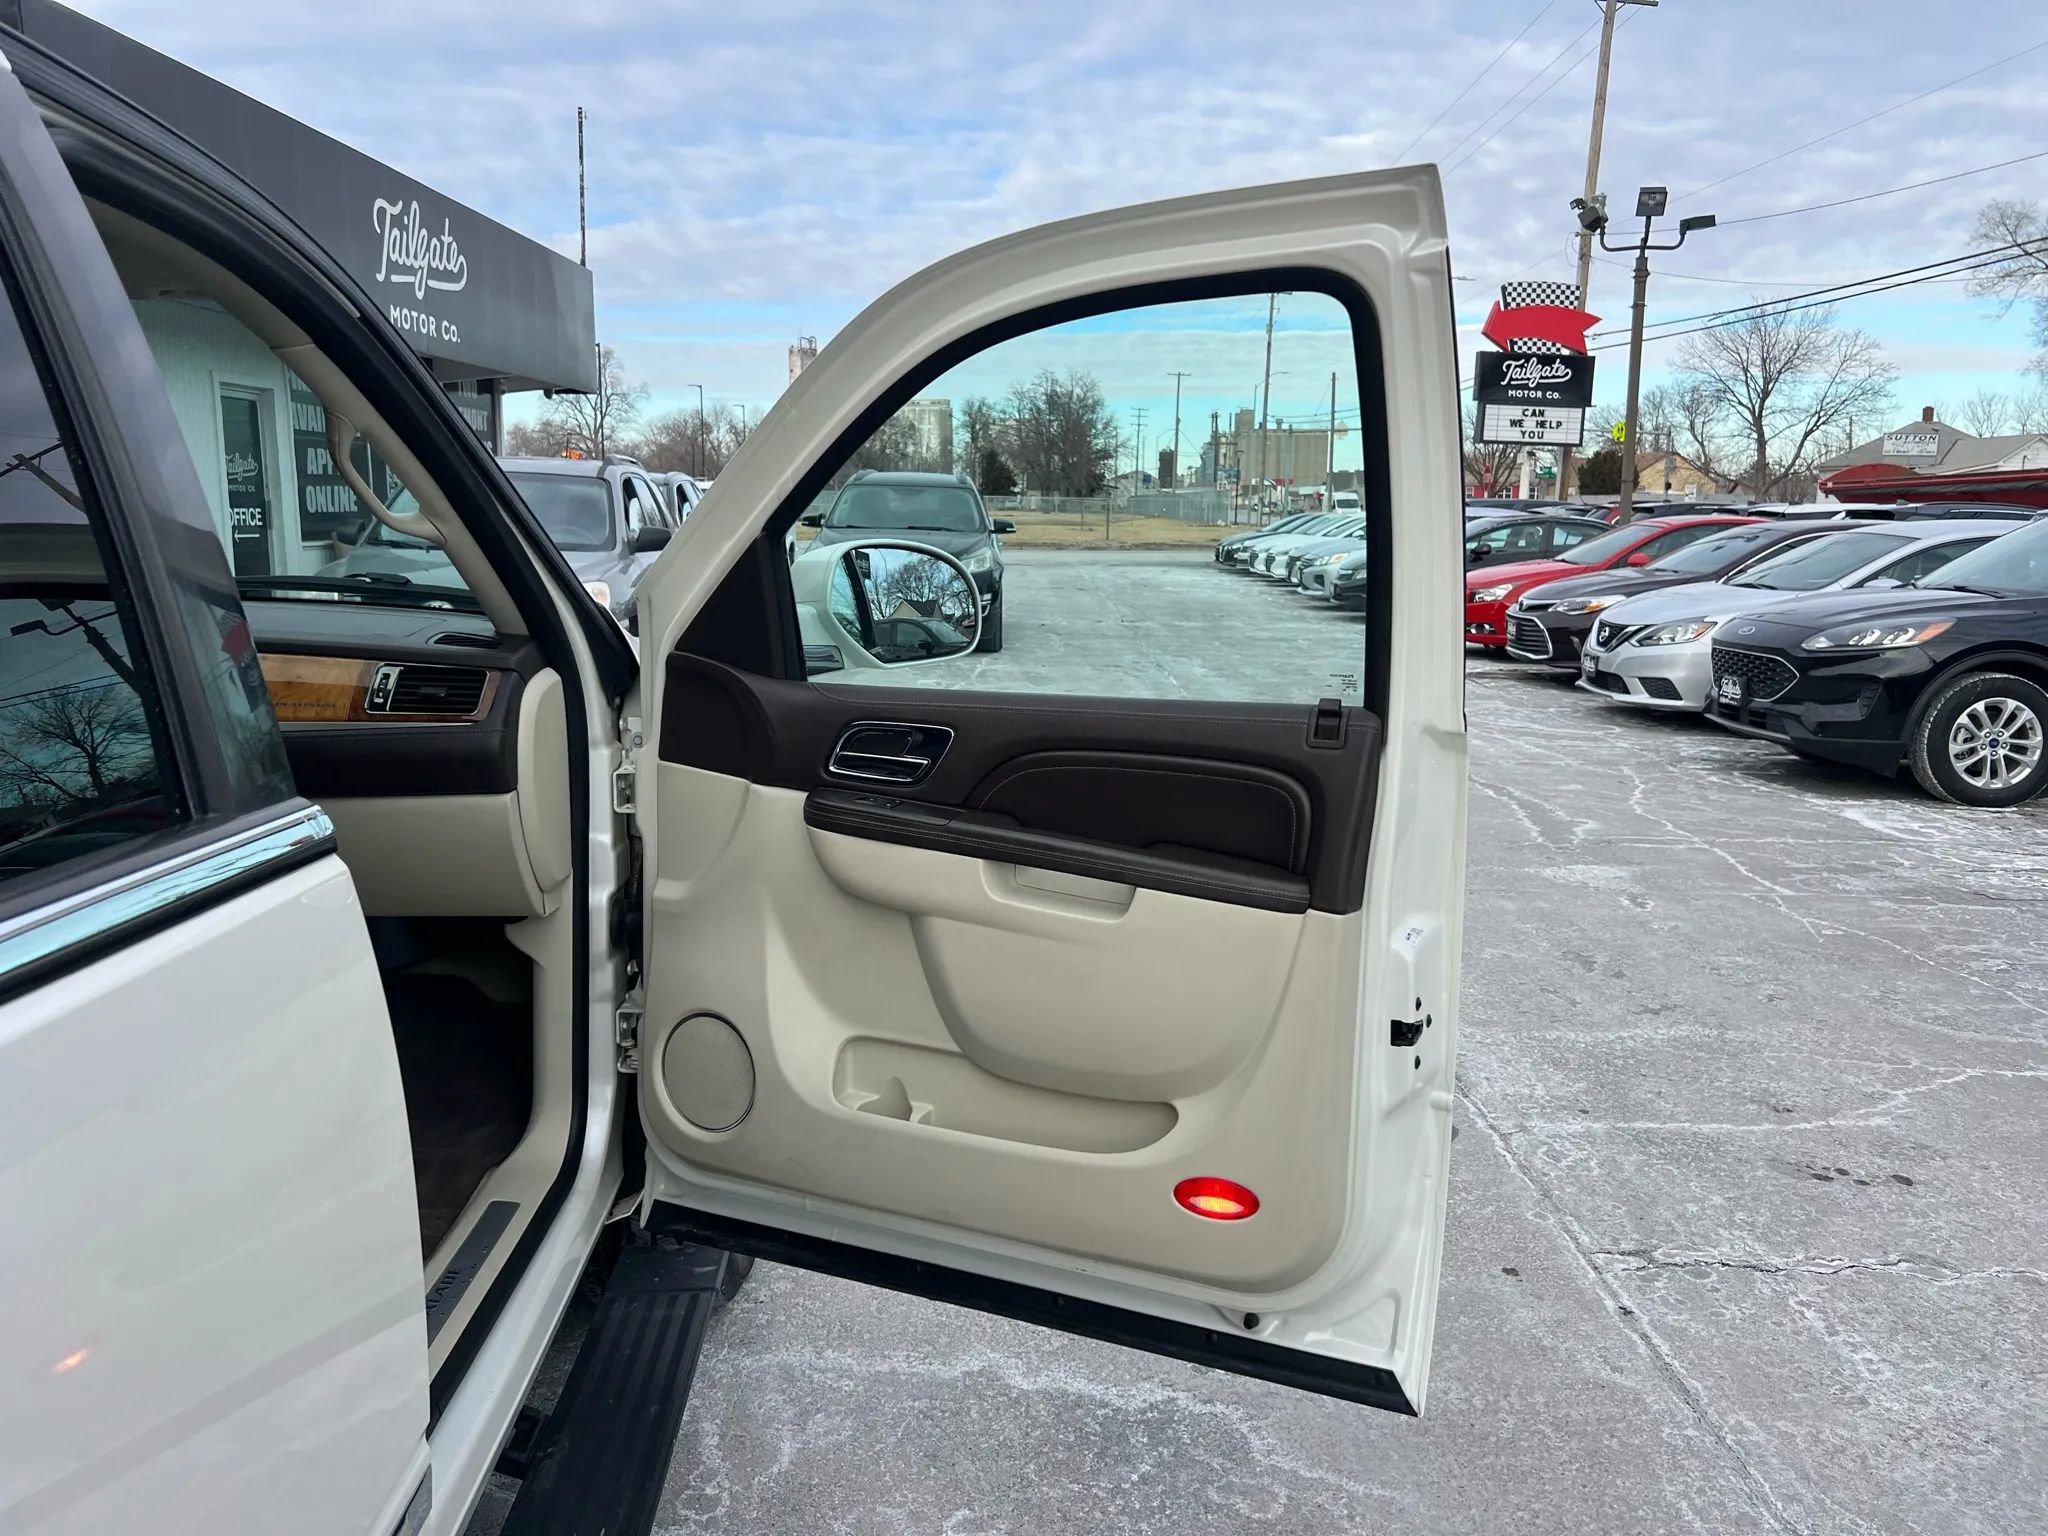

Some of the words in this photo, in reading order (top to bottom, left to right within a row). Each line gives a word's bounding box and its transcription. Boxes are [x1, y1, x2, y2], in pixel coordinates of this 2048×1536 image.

[373, 198, 467, 300] Tailgate
[390, 304, 437, 338] MOTOR
[442, 319, 461, 343] CO.
[1500, 357, 1572, 388] Tailgate
[1508, 390, 1542, 398] MOTOR
[1522, 408, 1545, 418] CAN
[1509, 419, 1525, 428] WE
[1535, 420, 1562, 430] HELP
[1520, 430, 1544, 440] YOU
[305, 485, 358, 513] ONLINE
